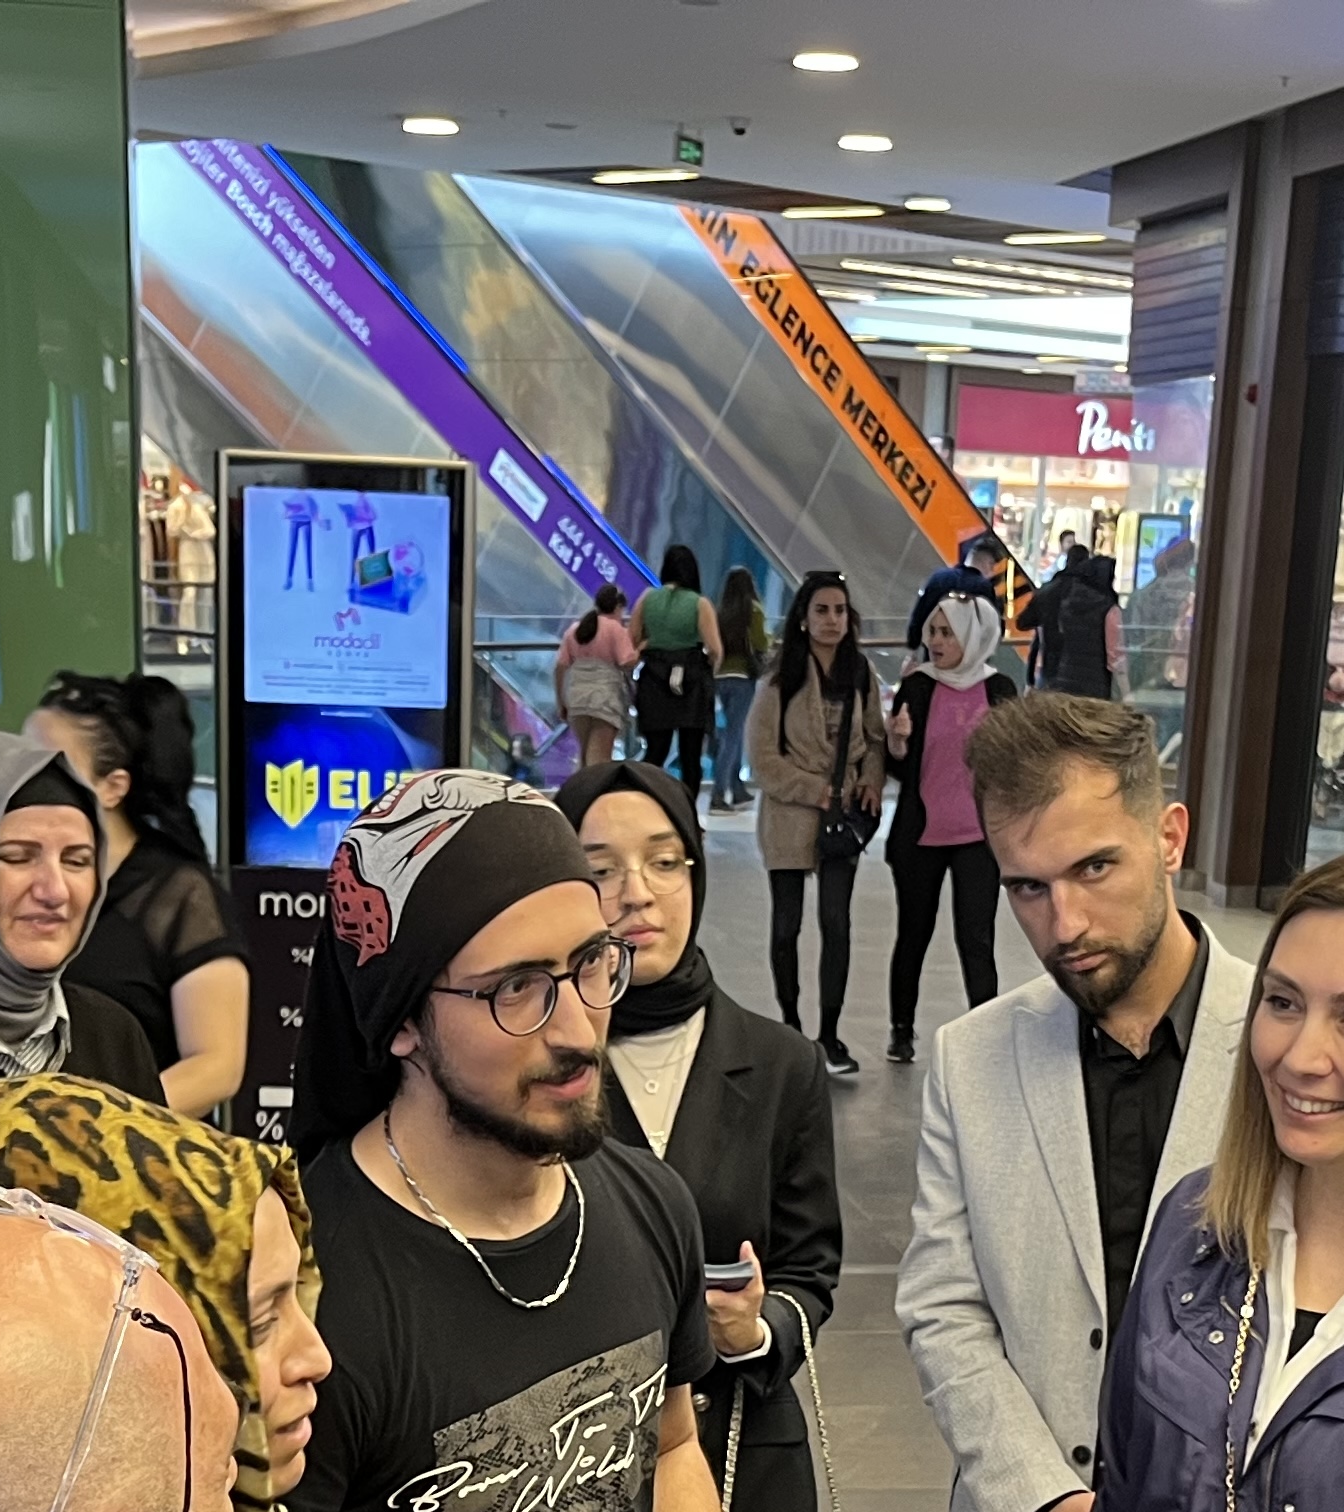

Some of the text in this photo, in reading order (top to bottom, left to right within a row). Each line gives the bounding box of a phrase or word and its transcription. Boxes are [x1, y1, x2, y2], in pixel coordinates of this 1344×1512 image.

[225, 178, 274, 237] Bosch
[738, 249, 844, 394] EĞLENCE
[840, 385, 938, 514] MERKEZİ
